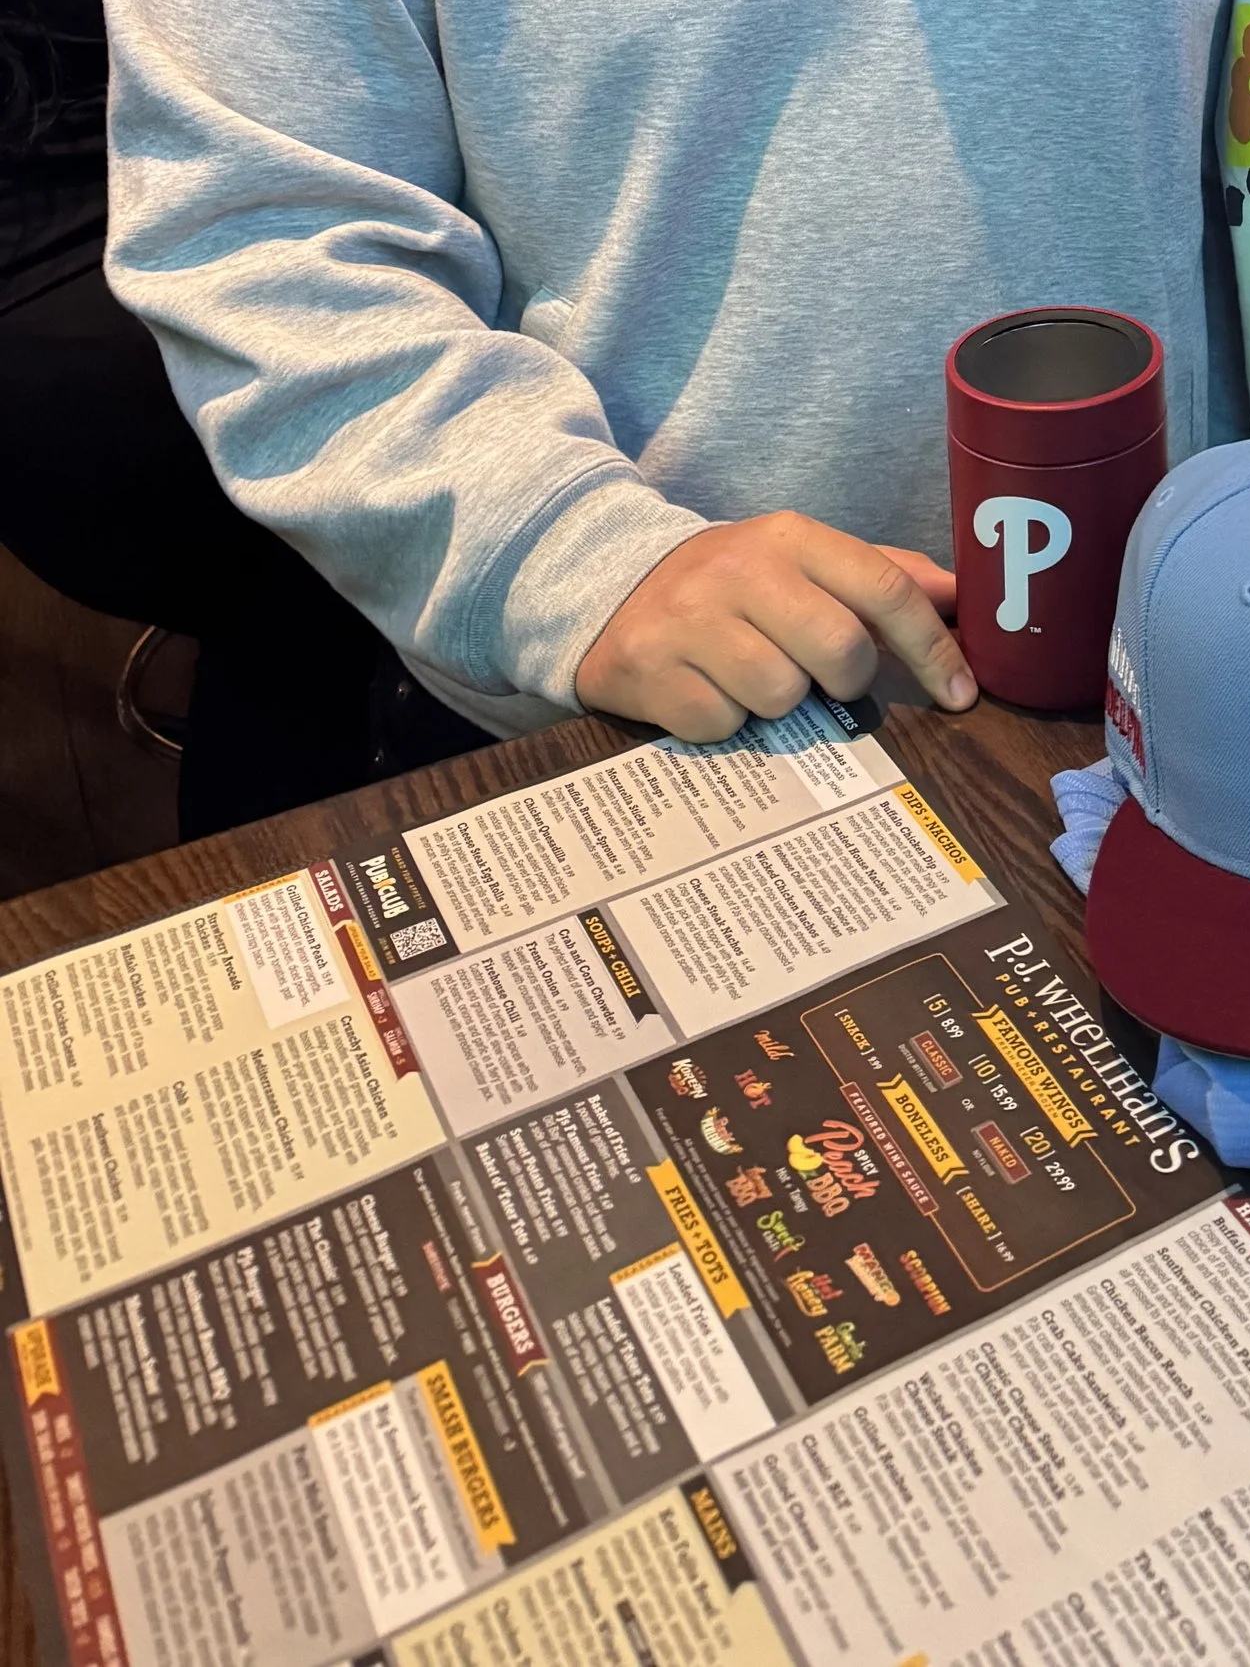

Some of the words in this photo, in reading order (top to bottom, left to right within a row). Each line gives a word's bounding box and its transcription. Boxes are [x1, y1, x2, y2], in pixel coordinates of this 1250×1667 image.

[973, 496, 1073, 632] P
[605, 767, 634, 805] Mozzarella
[628, 804, 648, 826] Sticks
[633, 757, 653, 777] Onion
[644, 777, 665, 798] Rings
[662, 746, 683, 769] Pretzel
[675, 769, 701, 798] Nuggets
[457, 822, 477, 848] Cheese
[470, 847, 488, 868] Steak
[523, 797, 545, 826] Chicken
[536, 825, 566, 863] Quesadilla
[564, 782, 585, 807] Buffalo
[578, 807, 602, 836] Brussels
[594, 836, 619, 864] Sprouts
[828, 821, 854, 848] Loaded
[848, 847, 870, 870] House
[865, 869, 890, 896] Nachos
[879, 801, 905, 827] Buffalo
[899, 826, 928, 856] Chicken
[921, 855, 938, 869] Dip
[900, 790, 927, 815] DIPS
[925, 821, 966, 865] NACHOS
[313, 869, 344, 912] SALADS
[477, 867, 495, 884] Egg
[488, 882, 505, 902] Rolls
[753, 851, 779, 879] Wicked
[772, 878, 800, 910] Chicken
[794, 910, 820, 938] Nachos
[193, 917, 213, 950] Chicken
[202, 912, 230, 957] Strawberry
[220, 955, 243, 991] Avocado
[284, 883, 305, 911] Grilled
[295, 910, 319, 945] Chicken
[309, 943, 329, 969] Peach
[688, 877, 712, 906] Cheese
[706, 905, 726, 927] Steak
[720, 926, 745, 956] Nachos
[481, 957, 509, 1000] Firehouse
[501, 999, 521, 1023] Chili
[525, 941, 548, 970] French
[540, 970, 562, 997] Onion
[558, 928, 576, 949] Crab
[569, 949, 585, 965] and
[578, 964, 597, 987] Corn
[590, 986, 618, 1026] Chowder
[584, 915, 615, 954] SOUPS
[609, 959, 640, 997] CHILI
[337, 1014, 363, 1052] Crunchy
[353, 1051, 375, 1080] Asian
[365, 1078, 391, 1119] Chicken
[733, 1065, 780, 1112] HOT
[991, 1017, 1044, 1078] FAMOUS
[1035, 1074, 1085, 1130] WINGS
[994, 972, 1031, 1009] PUB
[1033, 1019, 1140, 1149] RESTAURANT
[586, 1094, 612, 1127] Basket
[603, 1125, 619, 1139] of
[894, 1093, 949, 1164] BONELESS
[919, 1039, 952, 1076] CLASSIC
[960, 1098, 974, 1111] OR
[988, 1135, 1018, 1169] NAKED
[939, 1017, 964, 1040] 8.99
[988, 1084, 1017, 1113] 15.99
[1043, 1160, 1076, 1193] 29.99
[508, 1127, 531, 1157] Sweet
[522, 1155, 547, 1190] Potato
[537, 1187, 561, 1218] Fries
[562, 1123, 591, 1164] Famous
[582, 1162, 606, 1192] Fries
[608, 1136, 633, 1166] Fries
[799, 1110, 895, 1209] Peach
[849, 1091, 886, 1141] FEATURED
[883, 1142, 905, 1169] WING
[901, 1170, 929, 1204] SAUCE
[852, 1148, 878, 1177] SPICY
[774, 1166, 793, 1184] Hot
[786, 1188, 809, 1213] Tangy
[805, 1171, 851, 1219] BBQ
[663, 1184, 700, 1232] FRIES
[694, 1240, 729, 1286] TOTS
[1212, 1216, 1249, 1256] Buffalo
[484, 1271, 535, 1356] BURGERS
[667, 1262, 699, 1305] Loaded
[689, 1304, 715, 1336] Fries
[897, 1249, 951, 1317] SCORPION
[1155, 1246, 1204, 1303] Southwest
[1197, 1299, 1241, 1350] Chicken
[812, 1323, 855, 1375] PARM
[1098, 1277, 1140, 1327] Chicken
[1132, 1324, 1166, 1362] Bacon
[1159, 1358, 1195, 1400] Ranch
[425, 1372, 465, 1441] SMASH
[450, 1437, 500, 1532] BURGERS
[689, 1486, 738, 1562] MAINS
